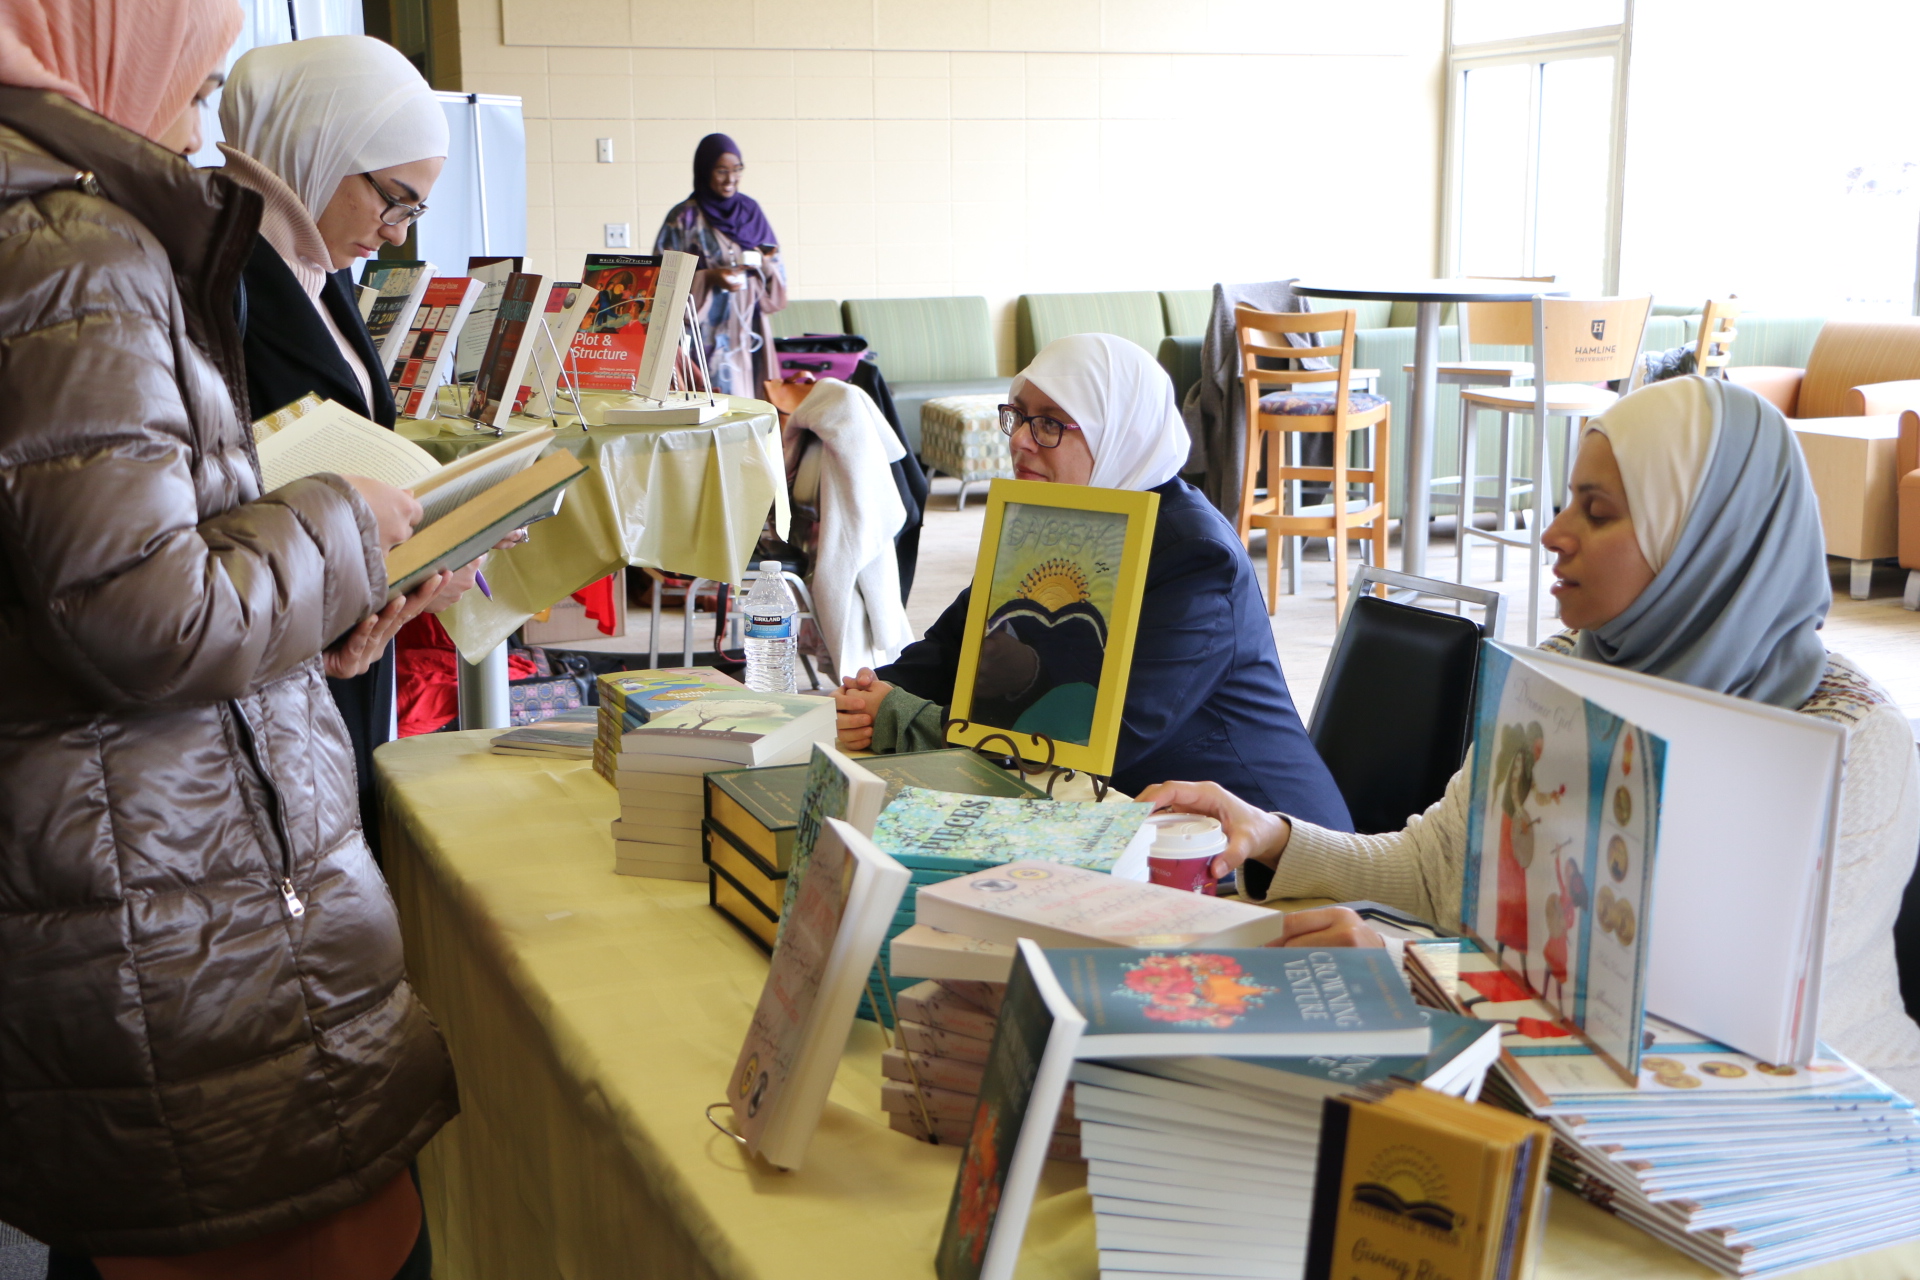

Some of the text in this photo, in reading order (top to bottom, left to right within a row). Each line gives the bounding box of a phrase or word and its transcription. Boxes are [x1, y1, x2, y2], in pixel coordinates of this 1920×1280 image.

[573, 346, 628, 361] Structure
[574, 332, 612, 346] Plot &
[1574, 345, 1616, 355] HAMLINE
[918, 799, 991, 851] PIECES
[1283, 959, 1329, 1021] VENTURE
[1308, 951, 1364, 1027] CROWNING
